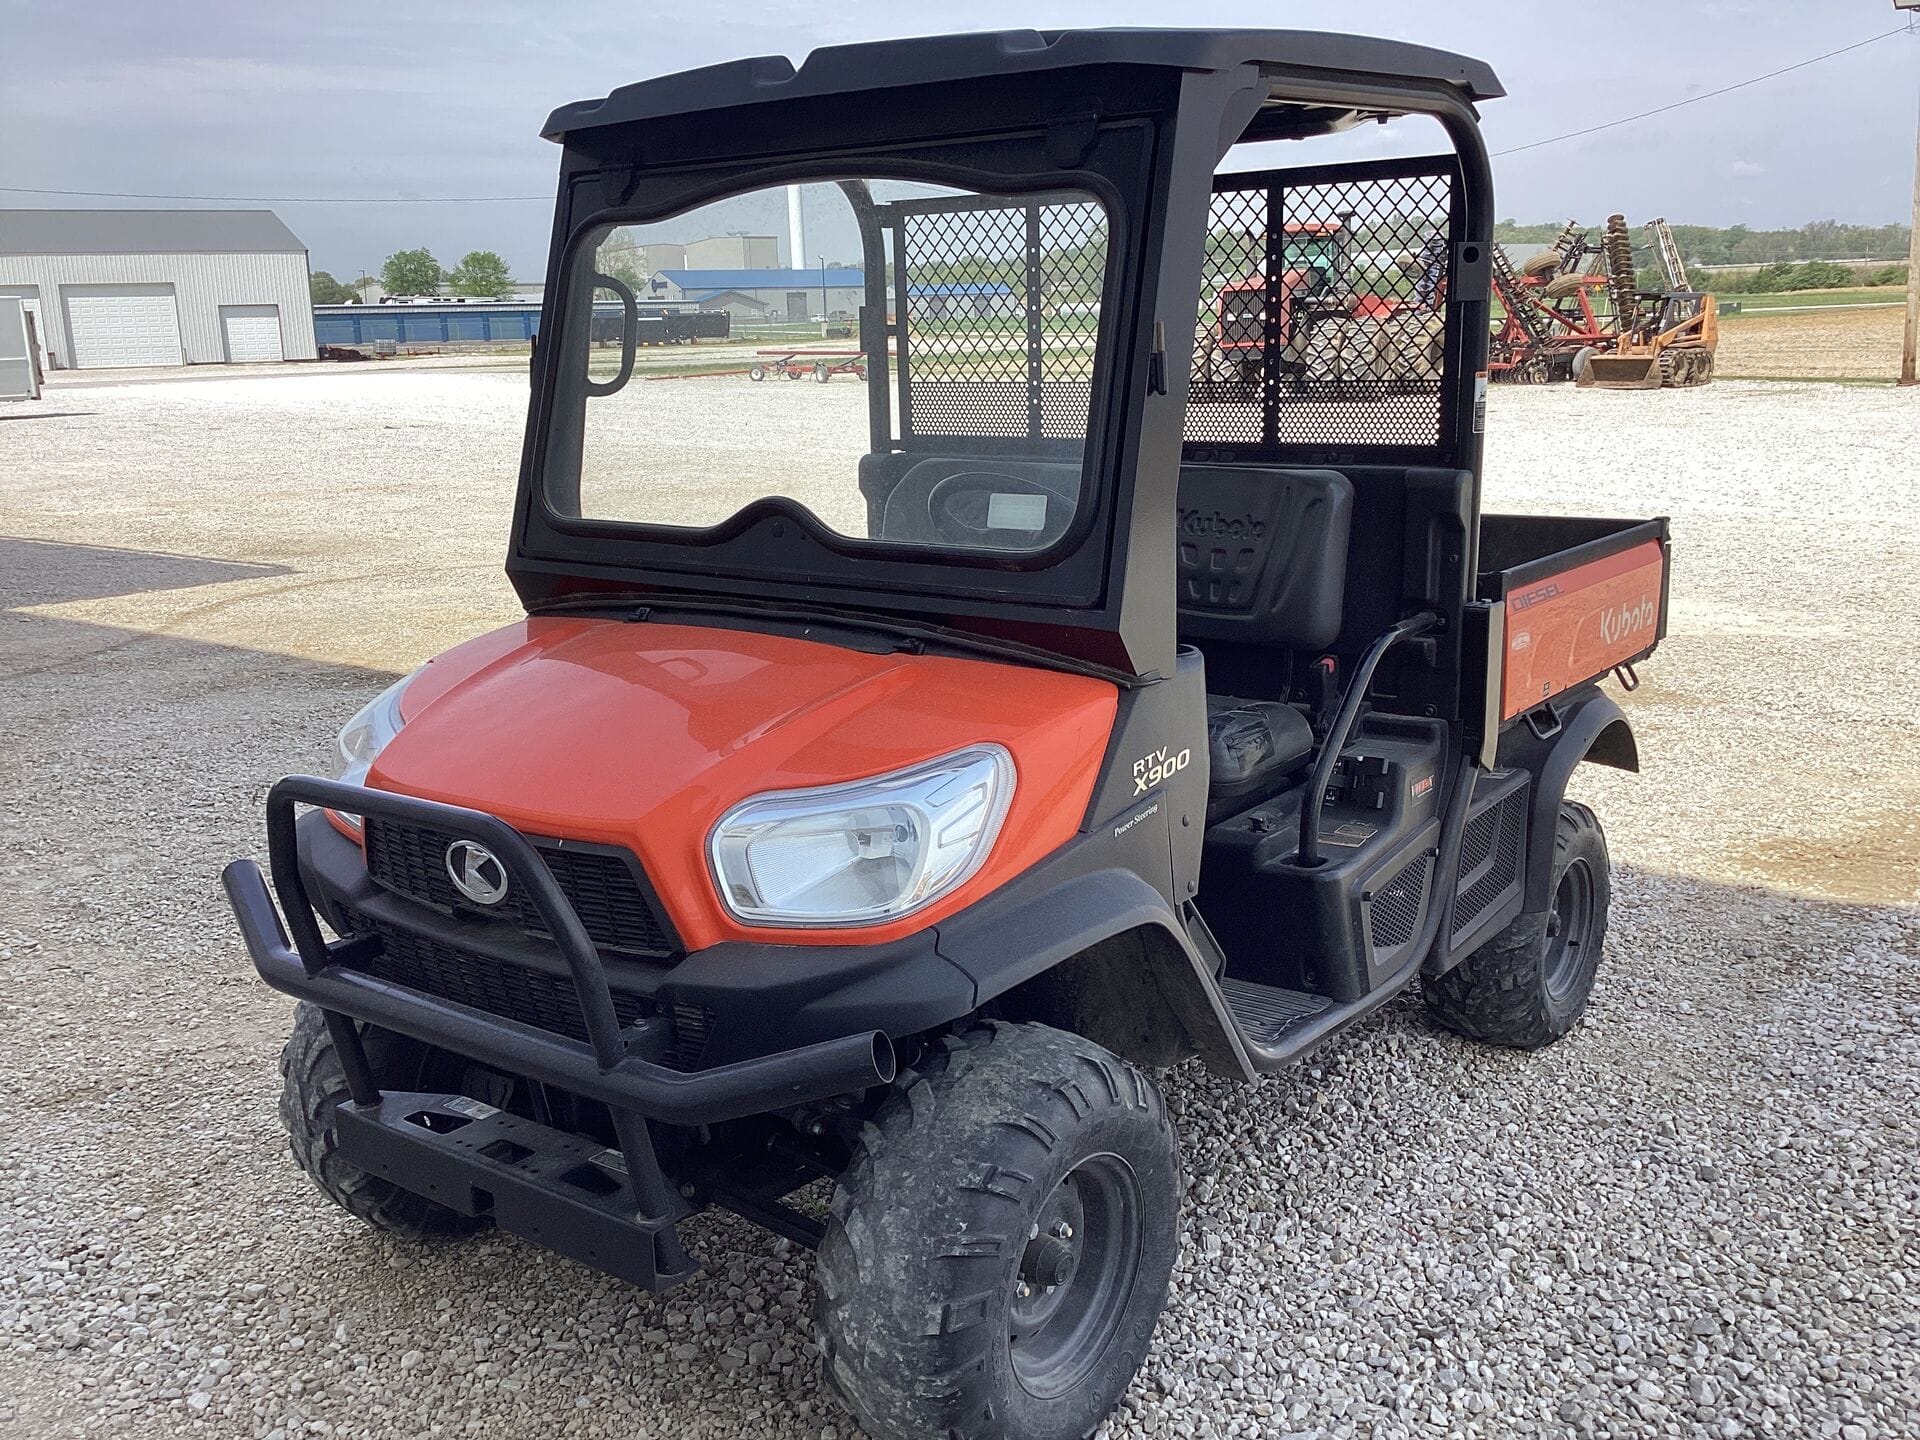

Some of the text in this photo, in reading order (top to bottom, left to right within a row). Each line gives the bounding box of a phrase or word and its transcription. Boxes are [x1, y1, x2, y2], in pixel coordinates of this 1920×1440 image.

[1511, 583, 1565, 611] DIESEL
[1600, 594, 1654, 645] Kubota
[1133, 745, 1168, 777] RTV
[1133, 748, 1190, 797] X900
[1114, 803, 1158, 838] Power Steering
